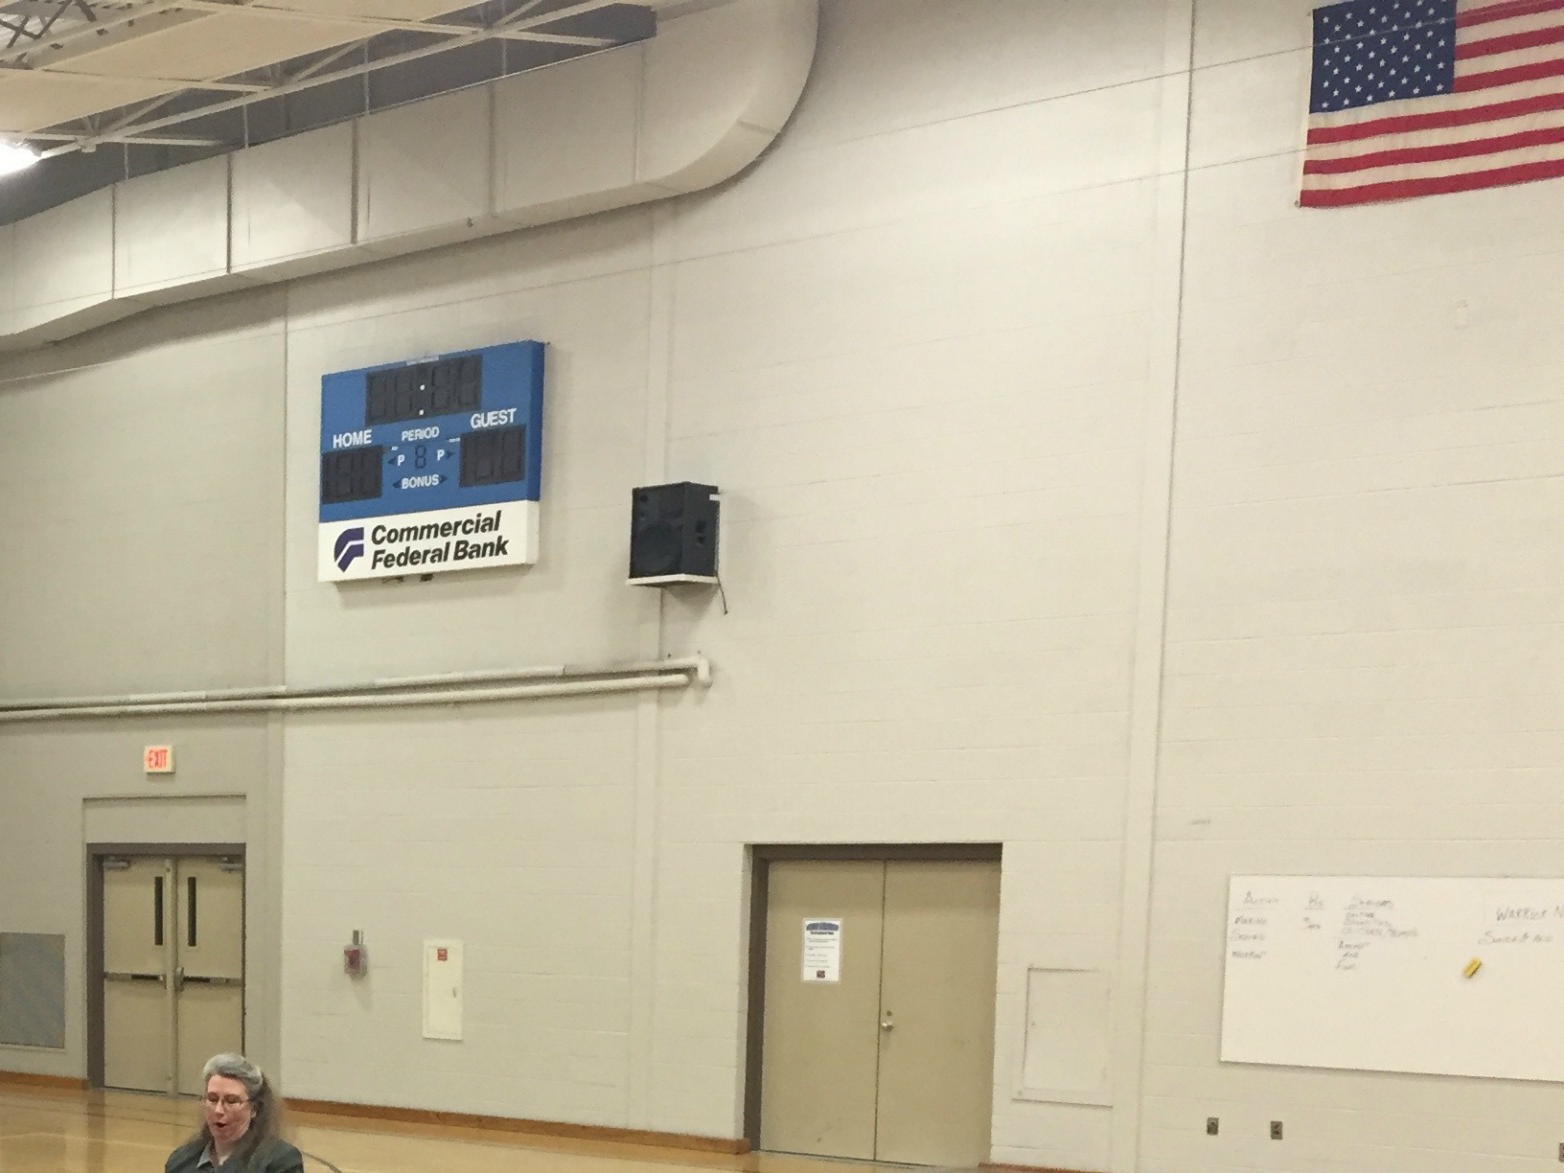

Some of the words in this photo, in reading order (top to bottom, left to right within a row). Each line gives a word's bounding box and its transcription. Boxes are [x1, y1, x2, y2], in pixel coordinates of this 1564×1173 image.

[470, 408, 517, 429] GUEST
[332, 429, 373, 449] HOME
[401, 426, 440, 442] PERIOD
[397, 454, 405, 467] P
[437, 449, 445, 461] P
[401, 474, 440, 490] BONUS
[371, 510, 502, 546] Commercial
[371, 542, 450, 570] Federal
[453, 535, 509, 561] Bank
[148, 748, 168, 768] EXIT
